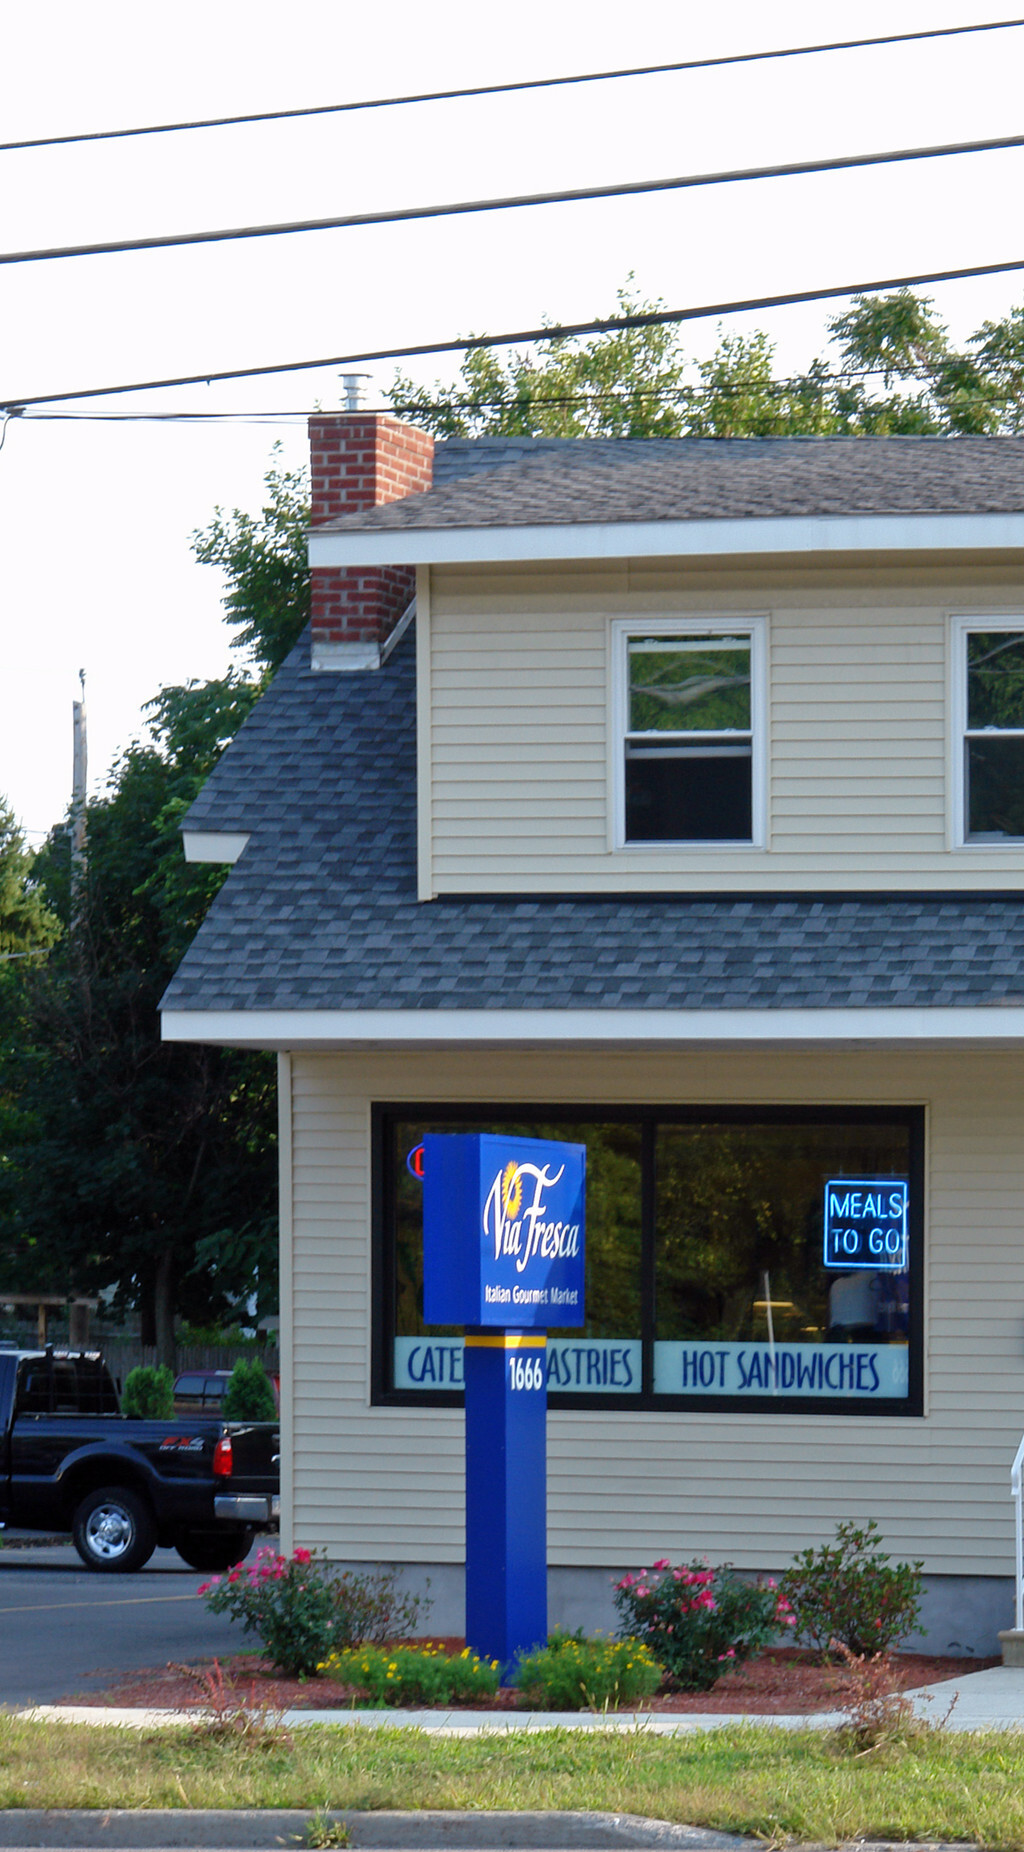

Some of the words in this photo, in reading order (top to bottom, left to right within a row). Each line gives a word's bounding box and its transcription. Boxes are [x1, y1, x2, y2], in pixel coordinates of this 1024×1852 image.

[484, 1168, 523, 1261] Via
[516, 1163, 580, 1273] Fresca
[830, 1192, 903, 1219] MEALS
[831, 1228, 859, 1254] TO
[869, 1227, 900, 1254] GO
[485, 1284, 511, 1304] Italian
[512, 1285, 548, 1304] Gourmet
[550, 1287, 578, 1305] Market
[407, 1346, 464, 1383] CATE
[546, 1348, 633, 1387] ASTRIES
[509, 1357, 543, 1391] 1666
[682, 1350, 731, 1388] HOT
[737, 1350, 880, 1392] SANDWICHES
